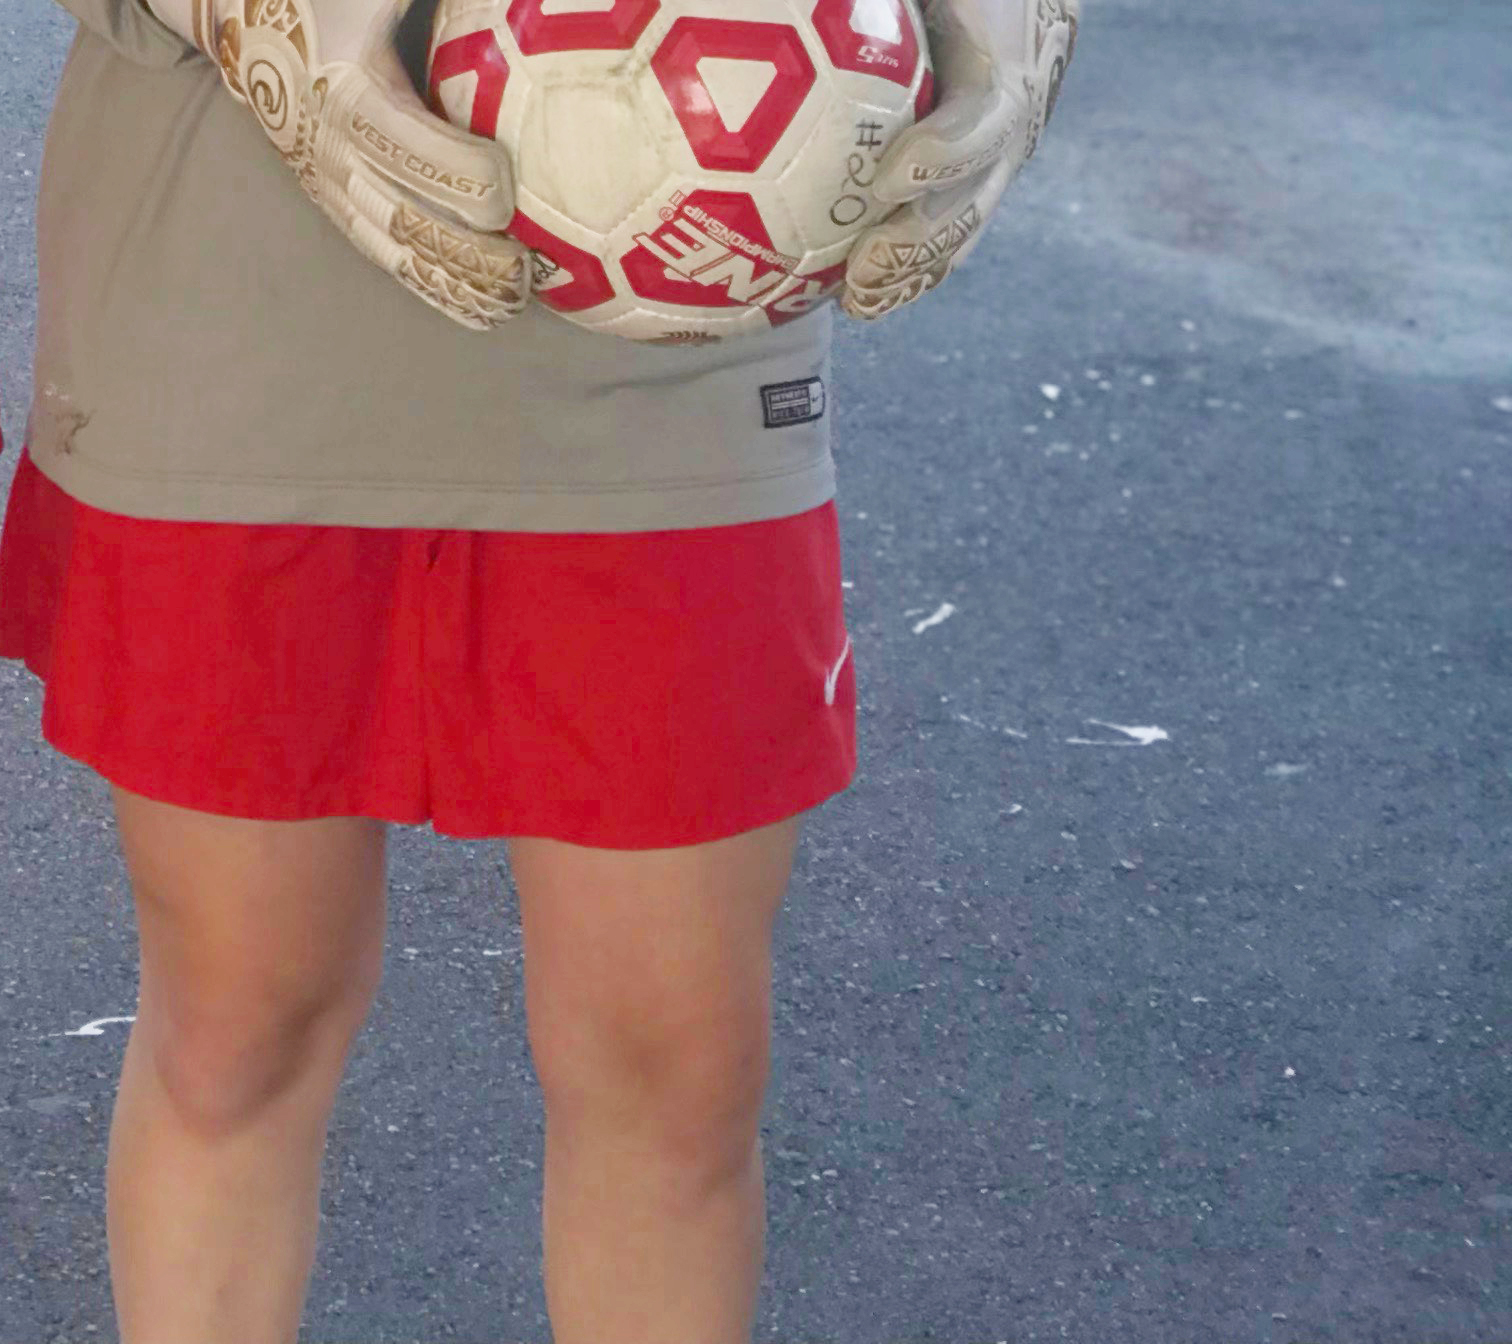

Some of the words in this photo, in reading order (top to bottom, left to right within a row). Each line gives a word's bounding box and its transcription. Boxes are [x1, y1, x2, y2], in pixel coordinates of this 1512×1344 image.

[352, 112, 402, 159] WEST
[404, 153, 494, 198] COAST
[682, 204, 800, 274] CHAMPIONSHIP
